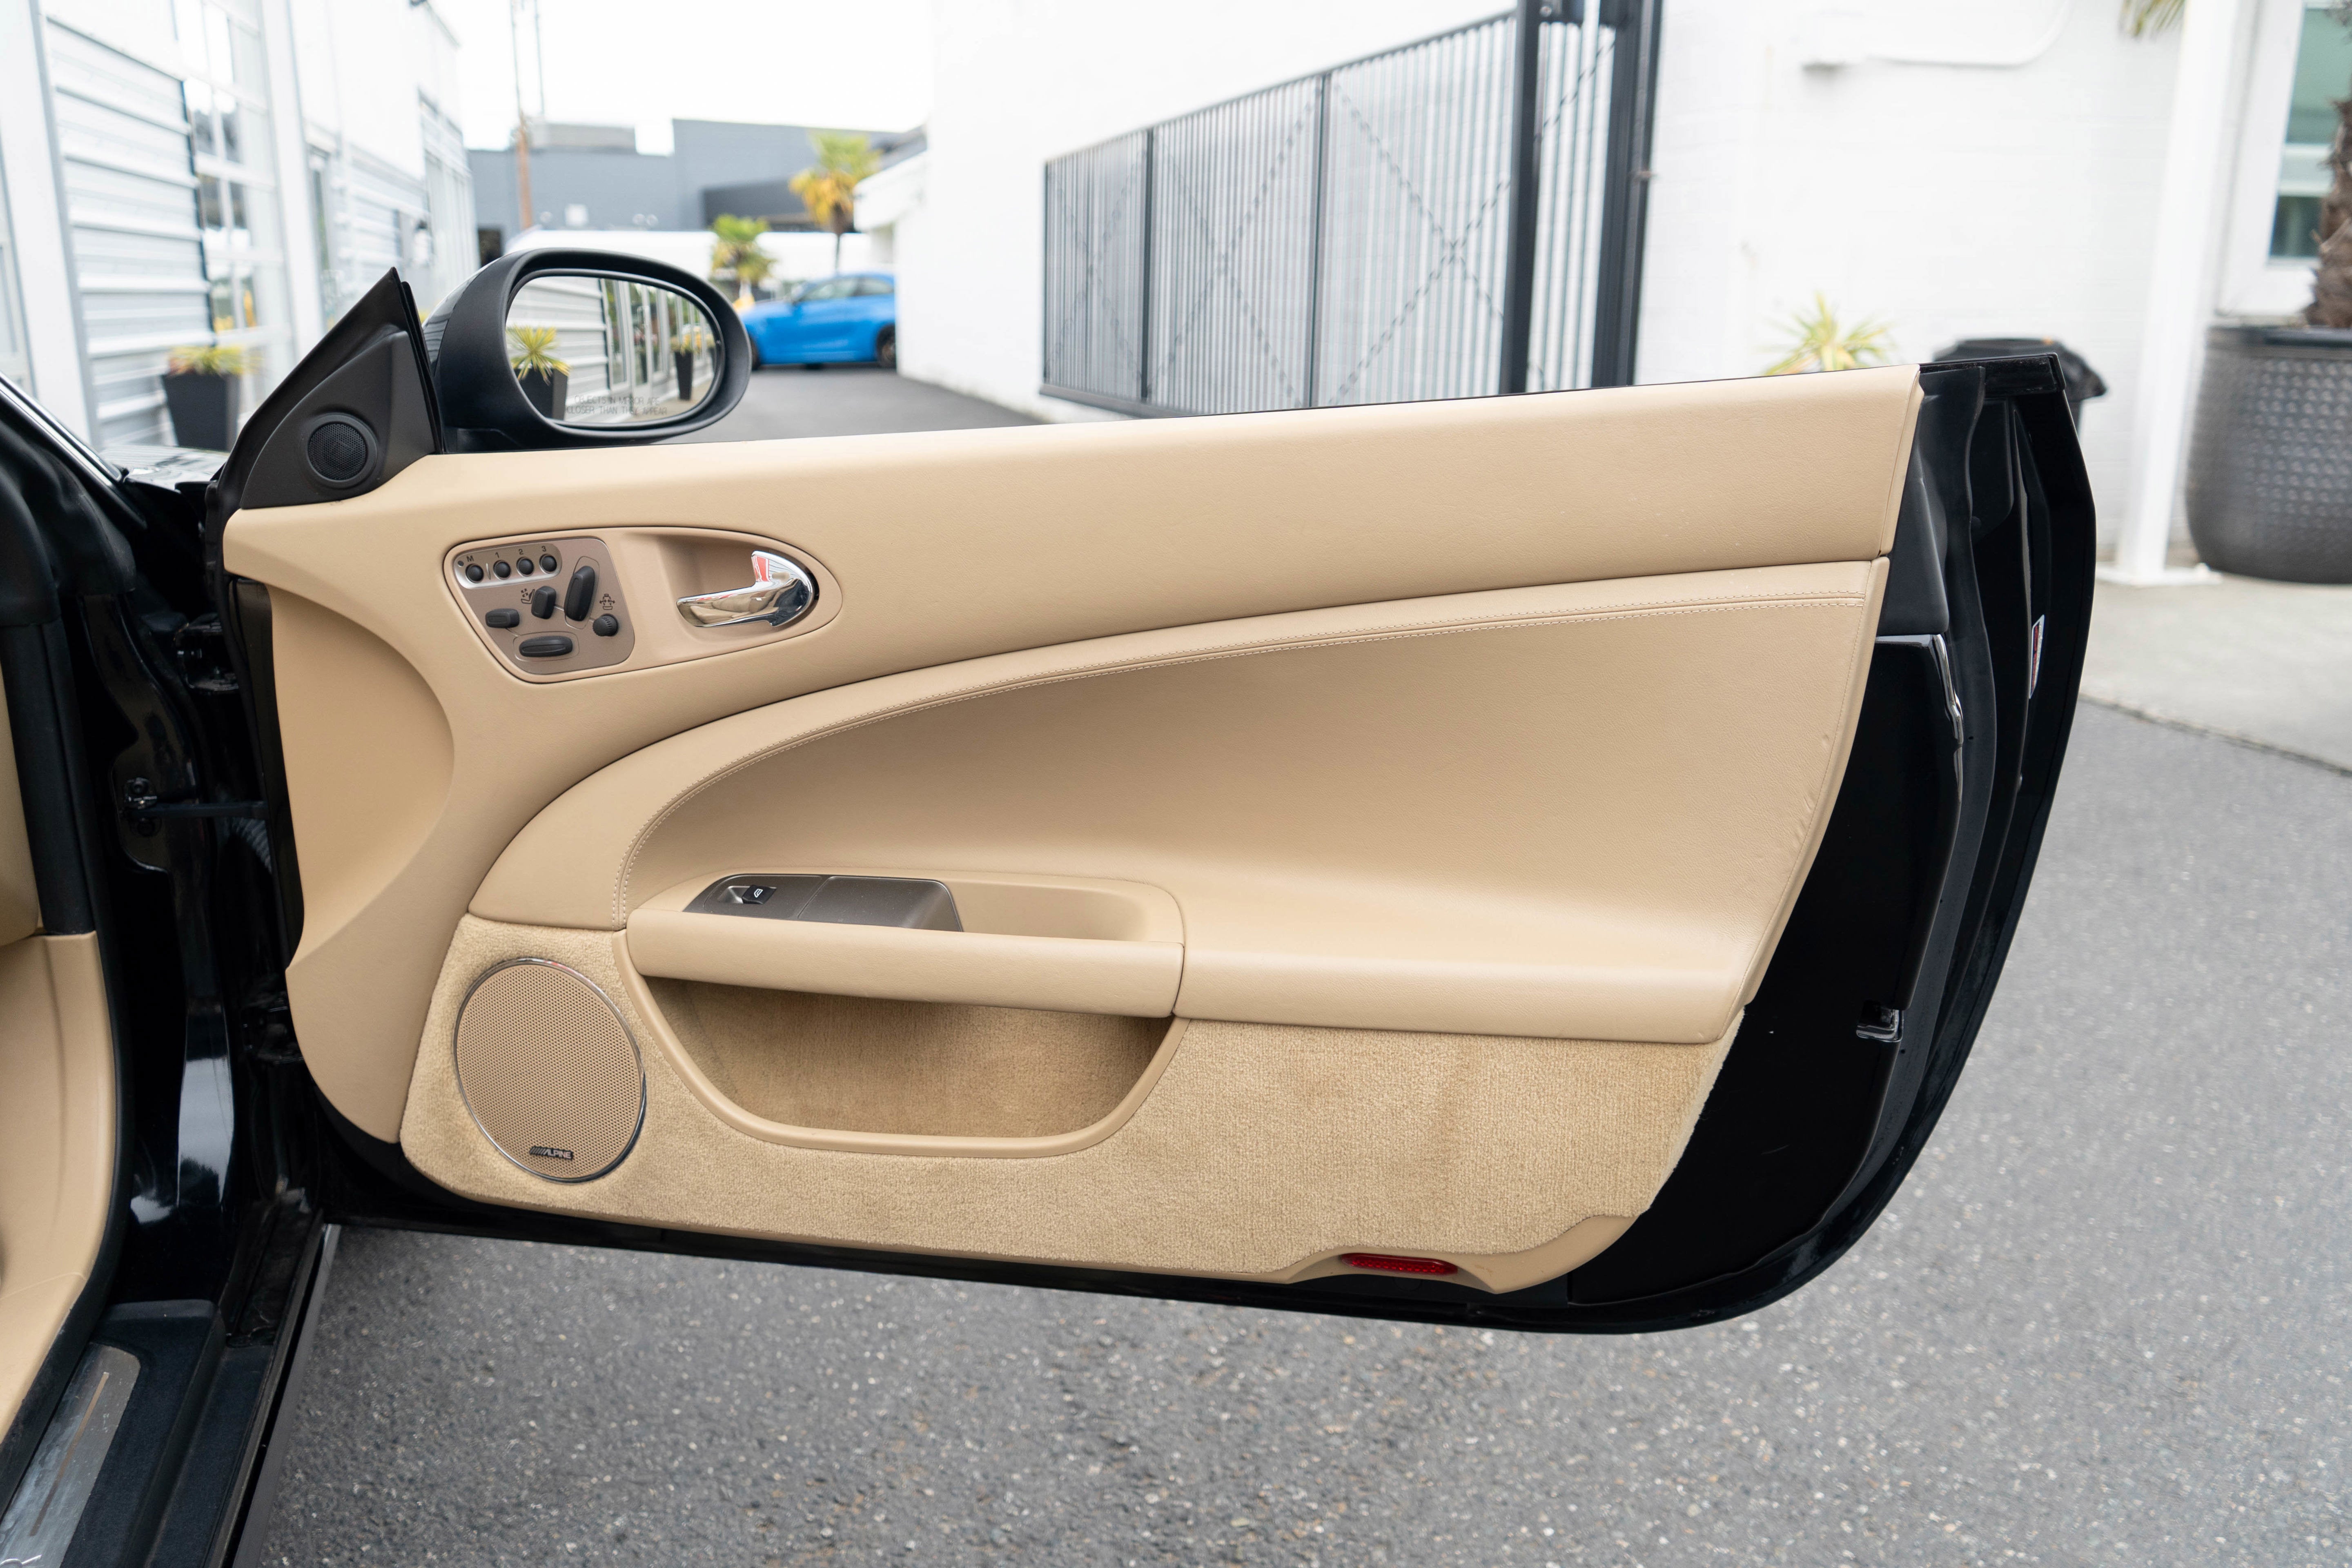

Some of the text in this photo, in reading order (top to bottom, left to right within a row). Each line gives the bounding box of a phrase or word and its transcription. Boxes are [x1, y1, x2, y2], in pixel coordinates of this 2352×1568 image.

[574, 395, 606, 404] OBJECTS
[646, 396, 660, 405] ARE
[566, 405, 668, 415] CLOSER THAN THY APPEAR
[543, 1148, 571, 1159] ALPINE
